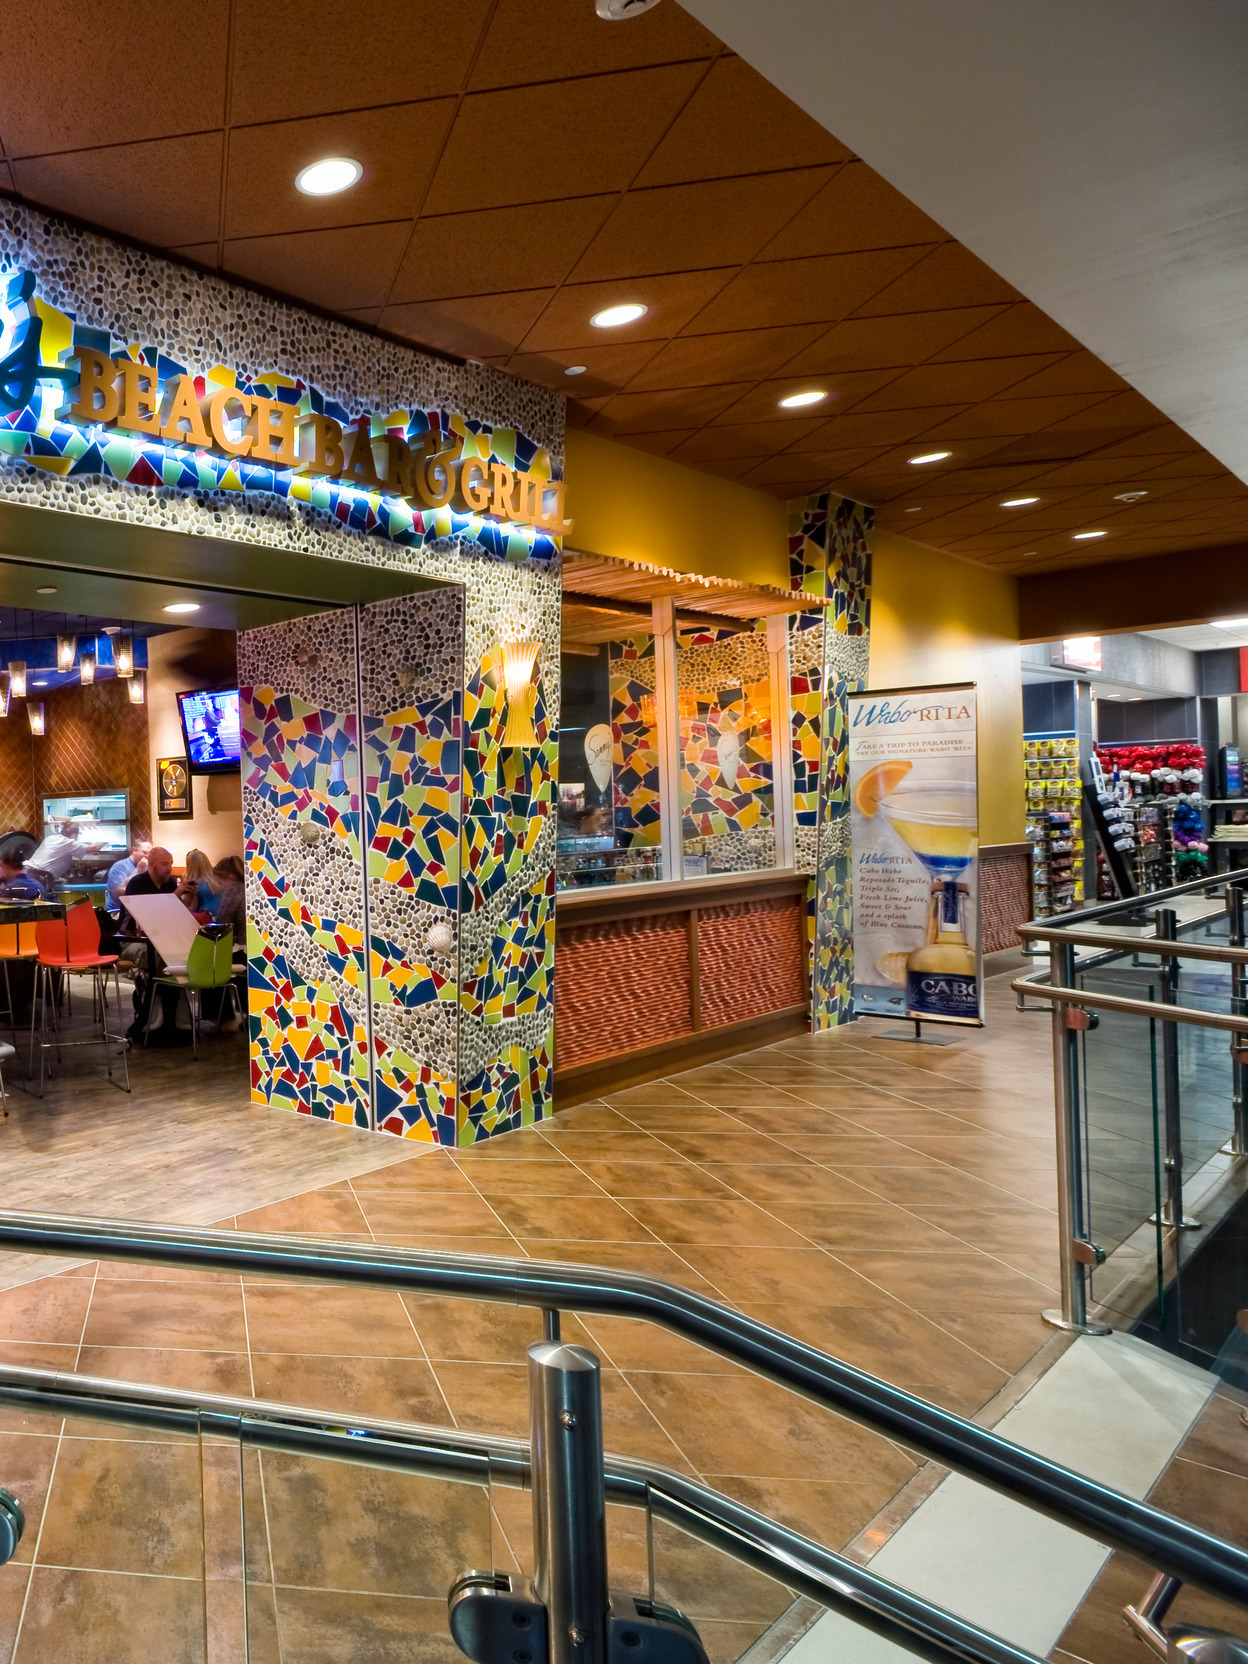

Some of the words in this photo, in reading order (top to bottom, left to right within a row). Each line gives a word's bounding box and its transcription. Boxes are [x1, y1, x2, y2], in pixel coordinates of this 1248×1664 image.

[70, 345, 301, 467] BEACH
[307, 413, 414, 497] BAR
[414, 430, 463, 509] &
[461, 457, 574, 535] GRILL
[852, 700, 912, 728] Wabo
[921, 739, 964, 747] PARADISE
[859, 876, 895, 884] Reposado
[860, 885, 883, 893] Triple
[859, 920, 869, 928] of
[870, 920, 888, 928] Blue
